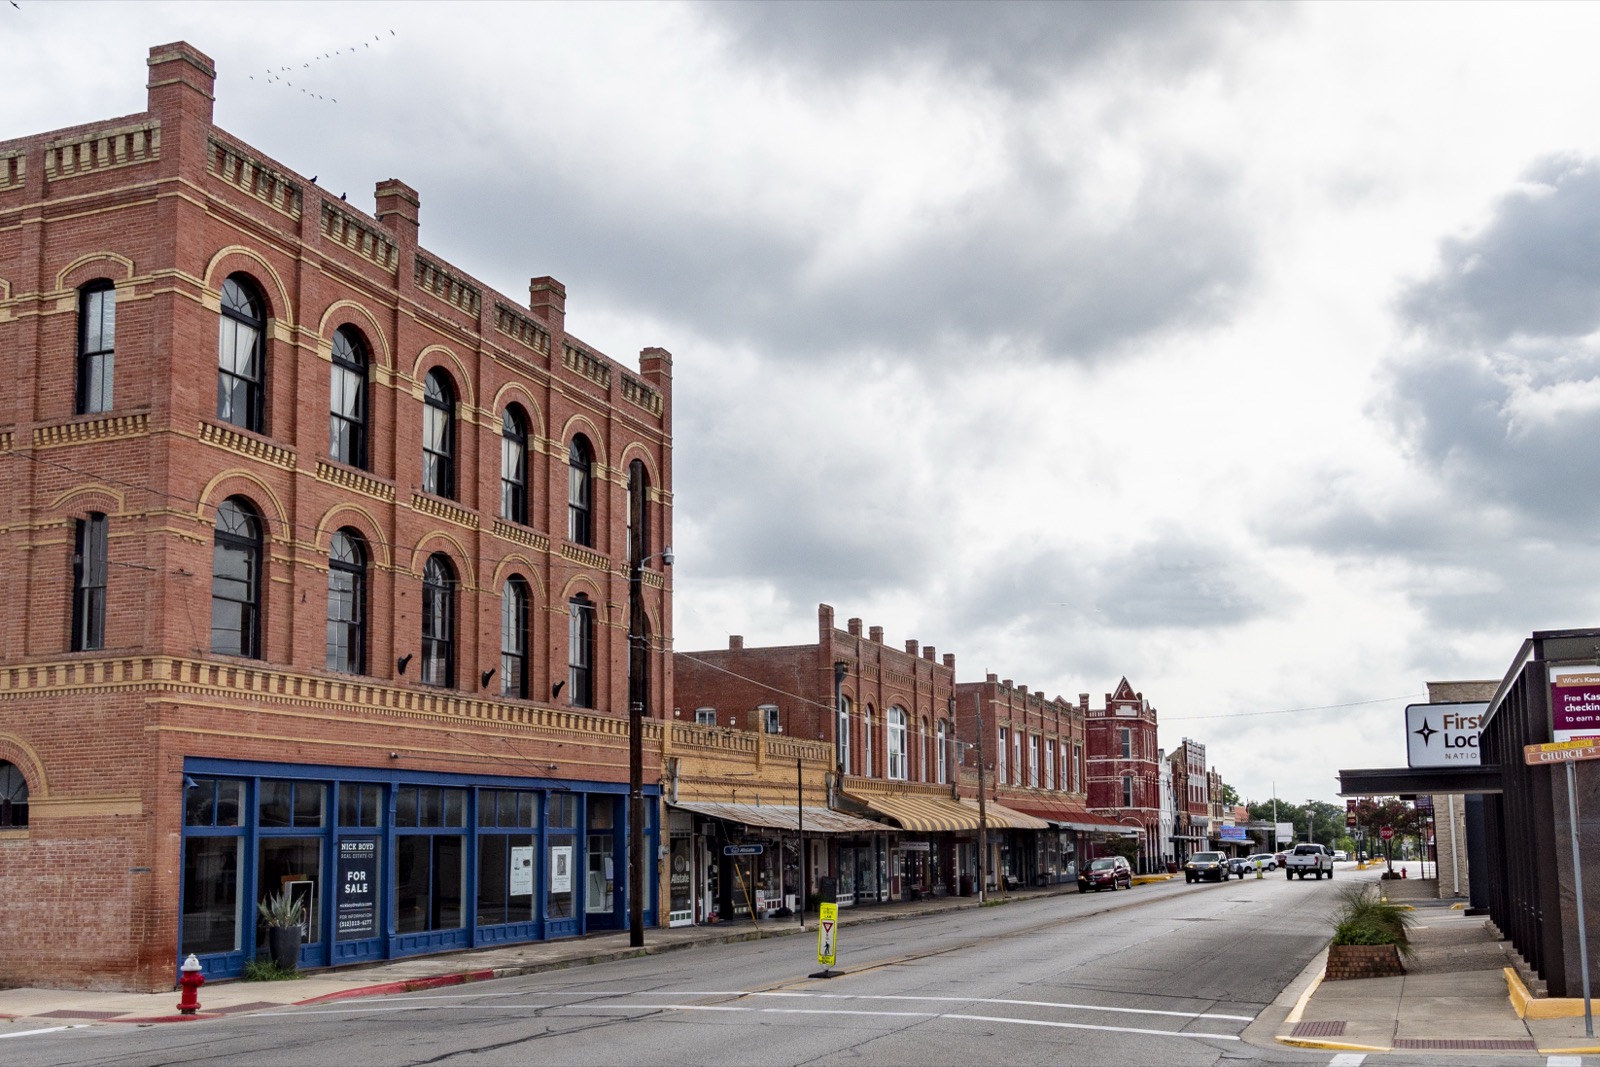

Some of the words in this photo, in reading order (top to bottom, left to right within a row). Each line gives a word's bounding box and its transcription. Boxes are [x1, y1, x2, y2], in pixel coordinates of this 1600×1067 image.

[1562, 677, 1583, 685] What's
[1564, 694, 1581, 702] Free
[1564, 702, 1600, 712] checkin
[1444, 731, 1482, 748] Loc
[1445, 752, 1477, 760] NATIO
[1540, 749, 1583, 761] CHURCH
[347, 871, 366, 881] FOR
[671, 873, 690, 884] Allstate
[344, 883, 368, 893] SALE
